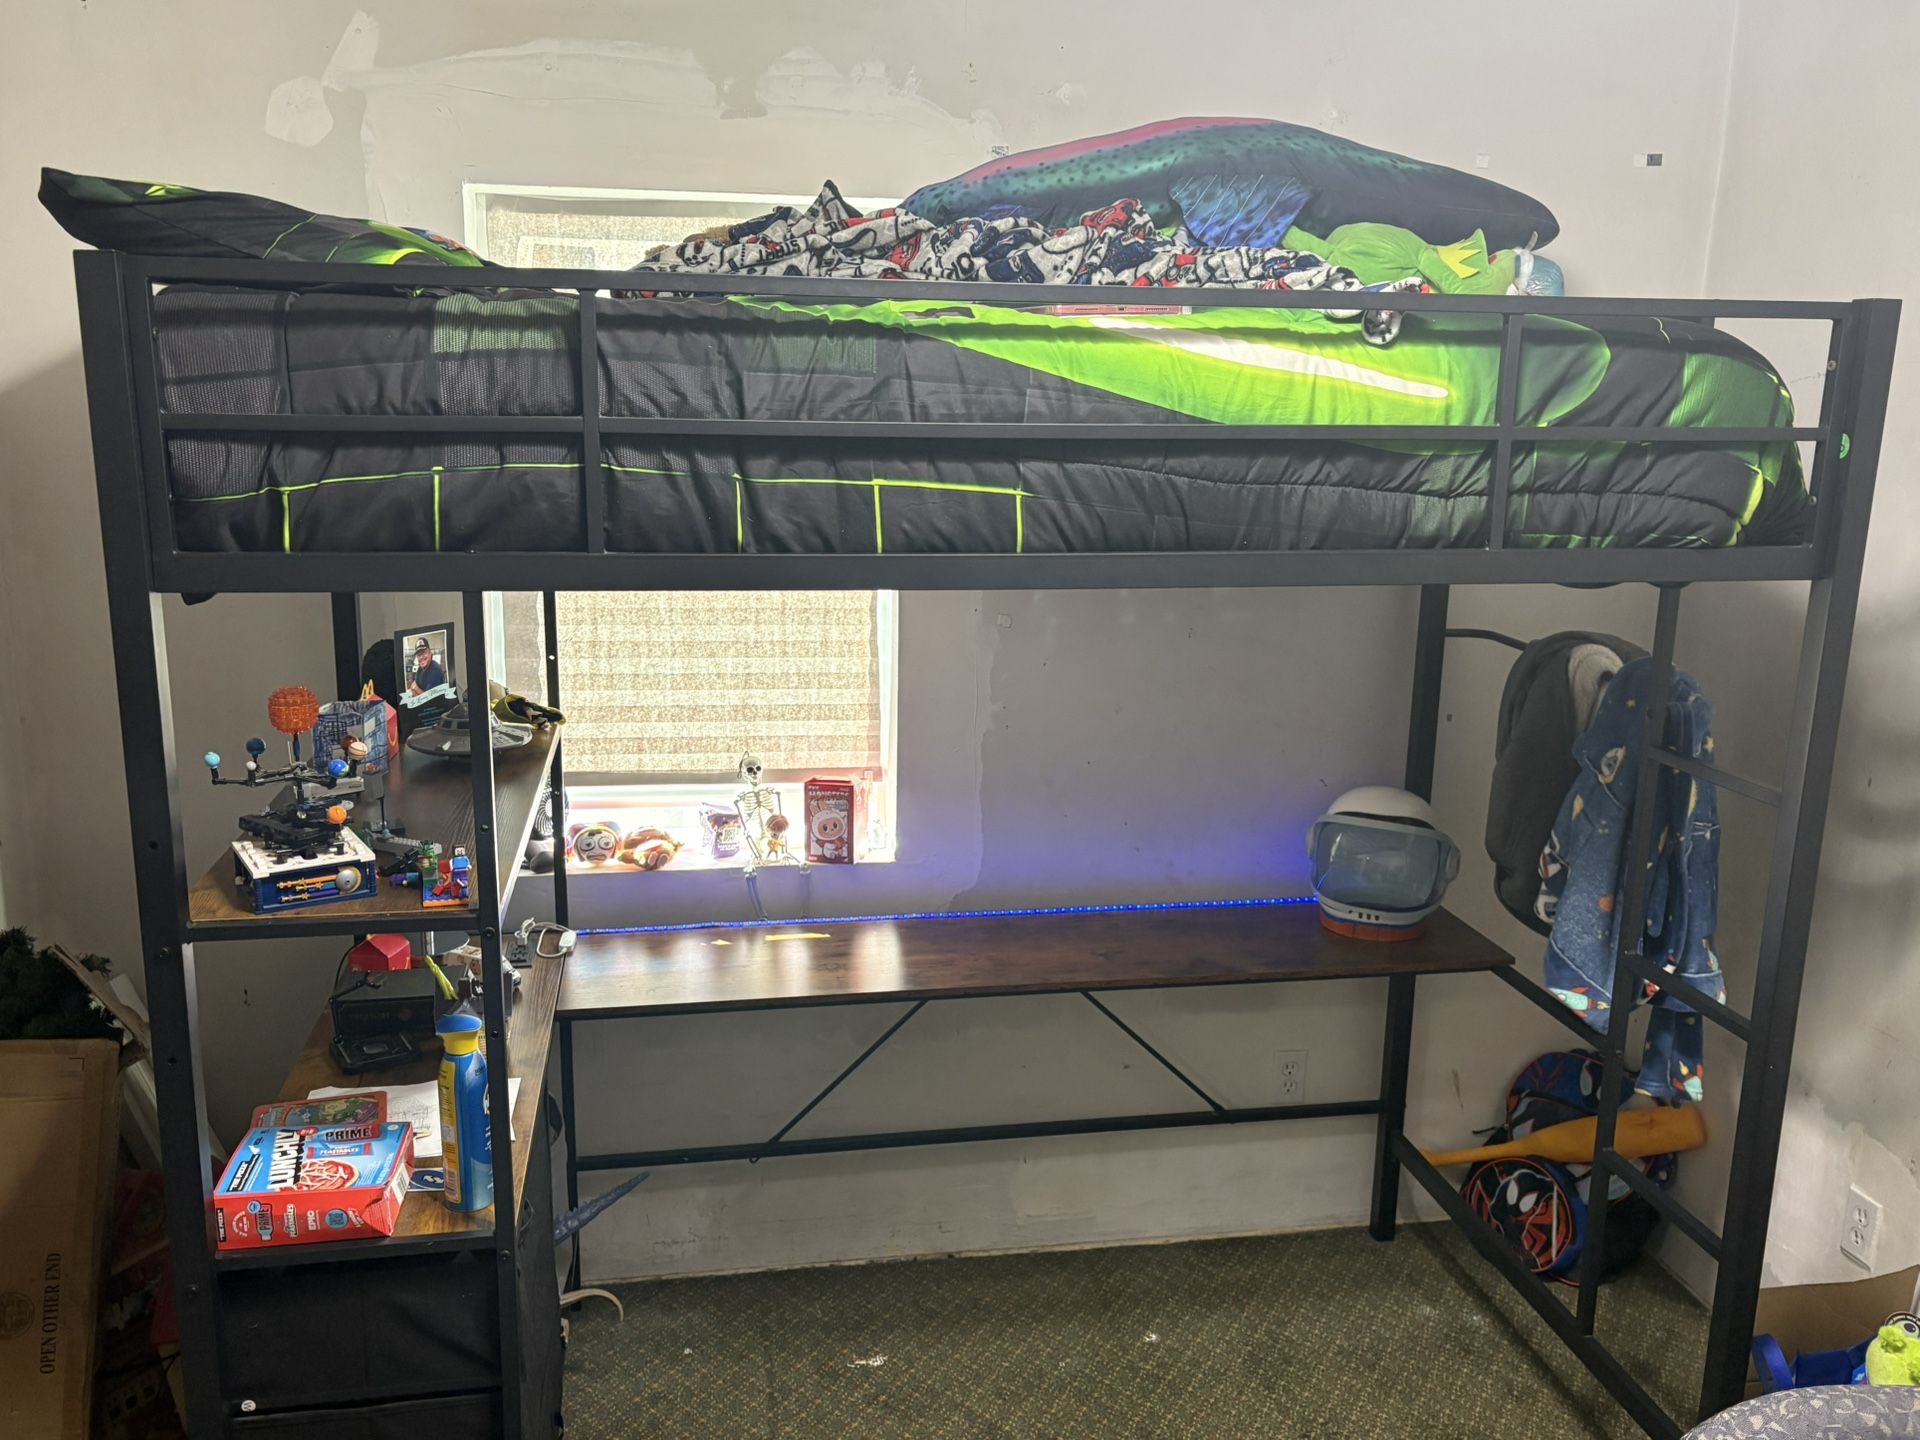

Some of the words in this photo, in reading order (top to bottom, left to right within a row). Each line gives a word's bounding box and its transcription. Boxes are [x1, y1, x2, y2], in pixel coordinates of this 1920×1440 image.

[325, 1127, 371, 1141] PRIME
[258, 1208, 271, 1231] PRIME
[307, 1210, 317, 1231] EPIC
[45, 1252, 62, 1281] END
[42, 1284, 60, 1334] OTHER
[39, 1336, 57, 1375] OPEN
